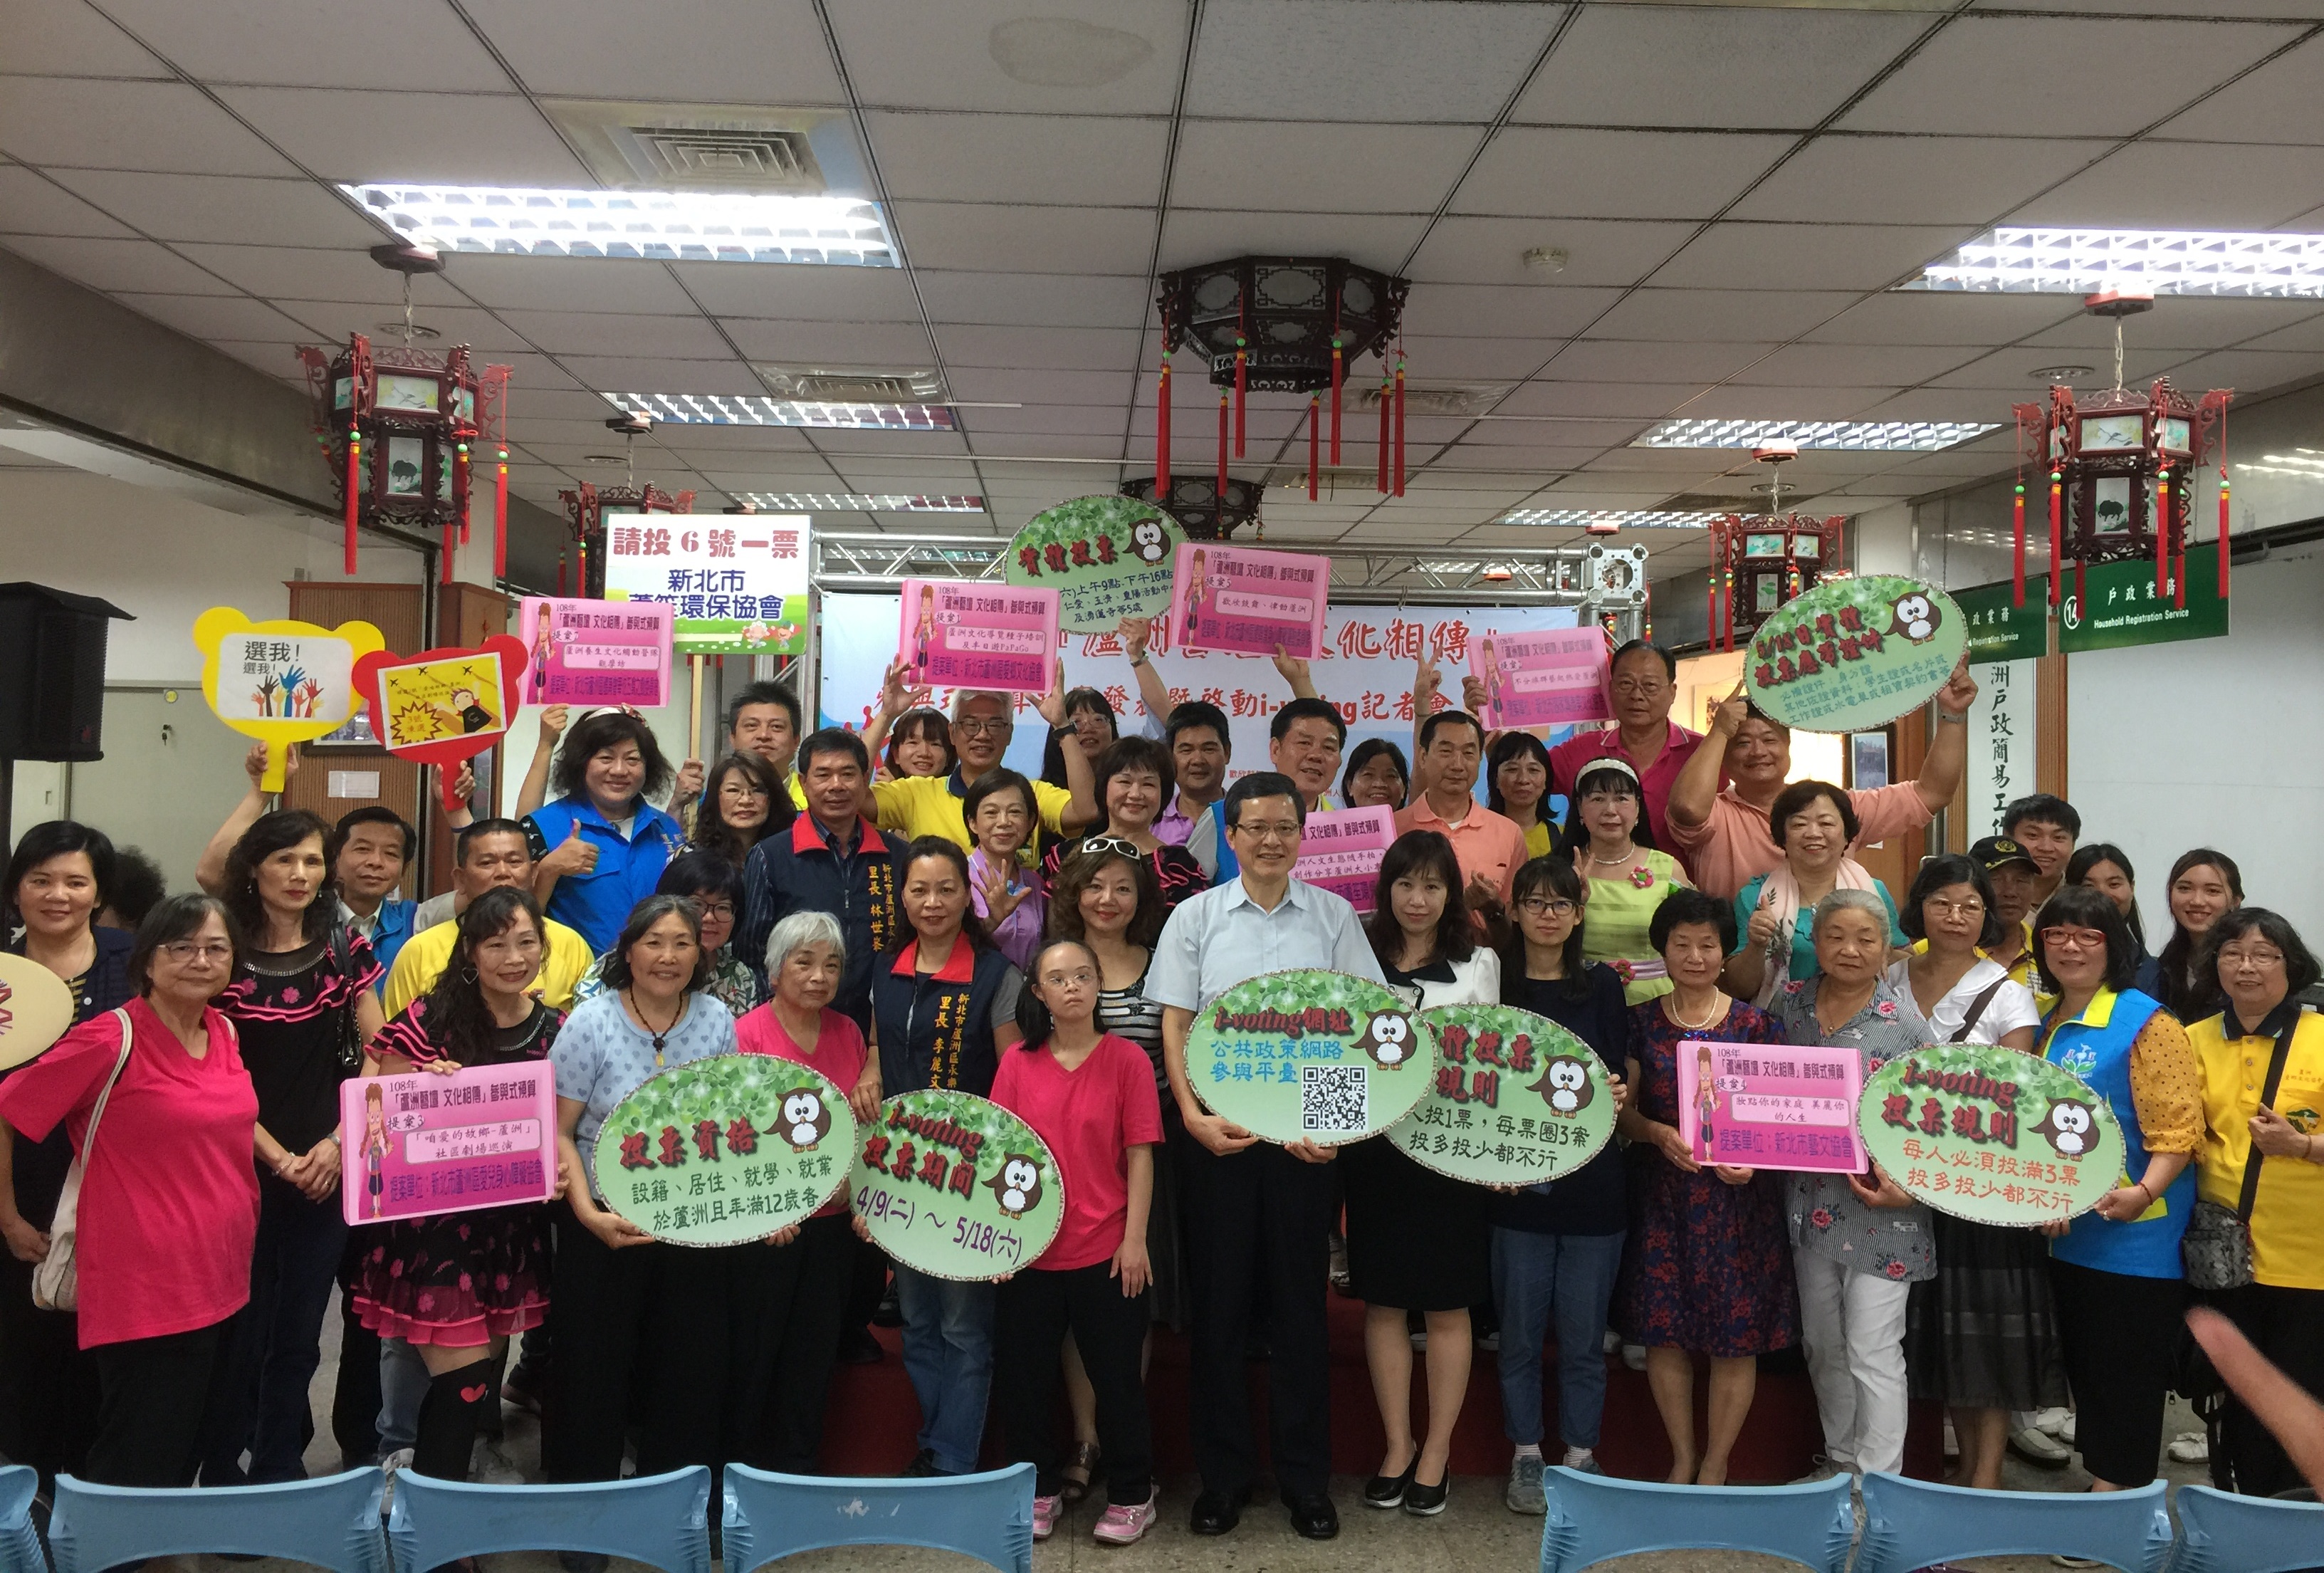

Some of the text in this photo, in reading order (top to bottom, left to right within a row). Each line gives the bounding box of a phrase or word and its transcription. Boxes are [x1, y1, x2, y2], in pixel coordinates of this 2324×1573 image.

[1018, 534, 1118, 578] 實體投票
[668, 569, 746, 593] 新北市
[938, 586, 960, 595] 108年
[2001, 632, 2019, 642] Service
[2093, 616, 2125, 629] Household
[2125, 611, 2163, 625] Registration
[2165, 607, 2190, 620] Service
[868, 865, 882, 896] 里長
[934, 995, 953, 1028] 里長
[1210, 1039, 1344, 1060] 公共政策網路
[1428, 1023, 1535, 1070] 體投票
[1717, 1047, 1741, 1057] 108年
[389, 1079, 419, 1092] 108年
[1210, 1062, 1299, 1084] 參與平臺
[1435, 1065, 1499, 1108] 規則
[1903, 1058, 2019, 1107] i-voting
[1774, 1112, 1808, 1123] 的人生
[1881, 1092, 2018, 1148] 投票規則
[435, 1140, 514, 1159] 社區劇場巡演
[619, 1116, 759, 1169] 投票資格
[1408, 1130, 1559, 1171] 投多投少都不行
[1902, 1138, 2081, 1187] 每人必須投滿3票
[631, 1154, 834, 1206] 設籍、居住、就學、就業
[862, 1133, 976, 1198] 投票期間
[653, 1186, 820, 1233] 於蘆洲且年滿12歲者
[1907, 1166, 2074, 1214] 投多投少都不行
[856, 1186, 916, 1230] 4/9(二)
[953, 1216, 1022, 1266] 5/18(六)
